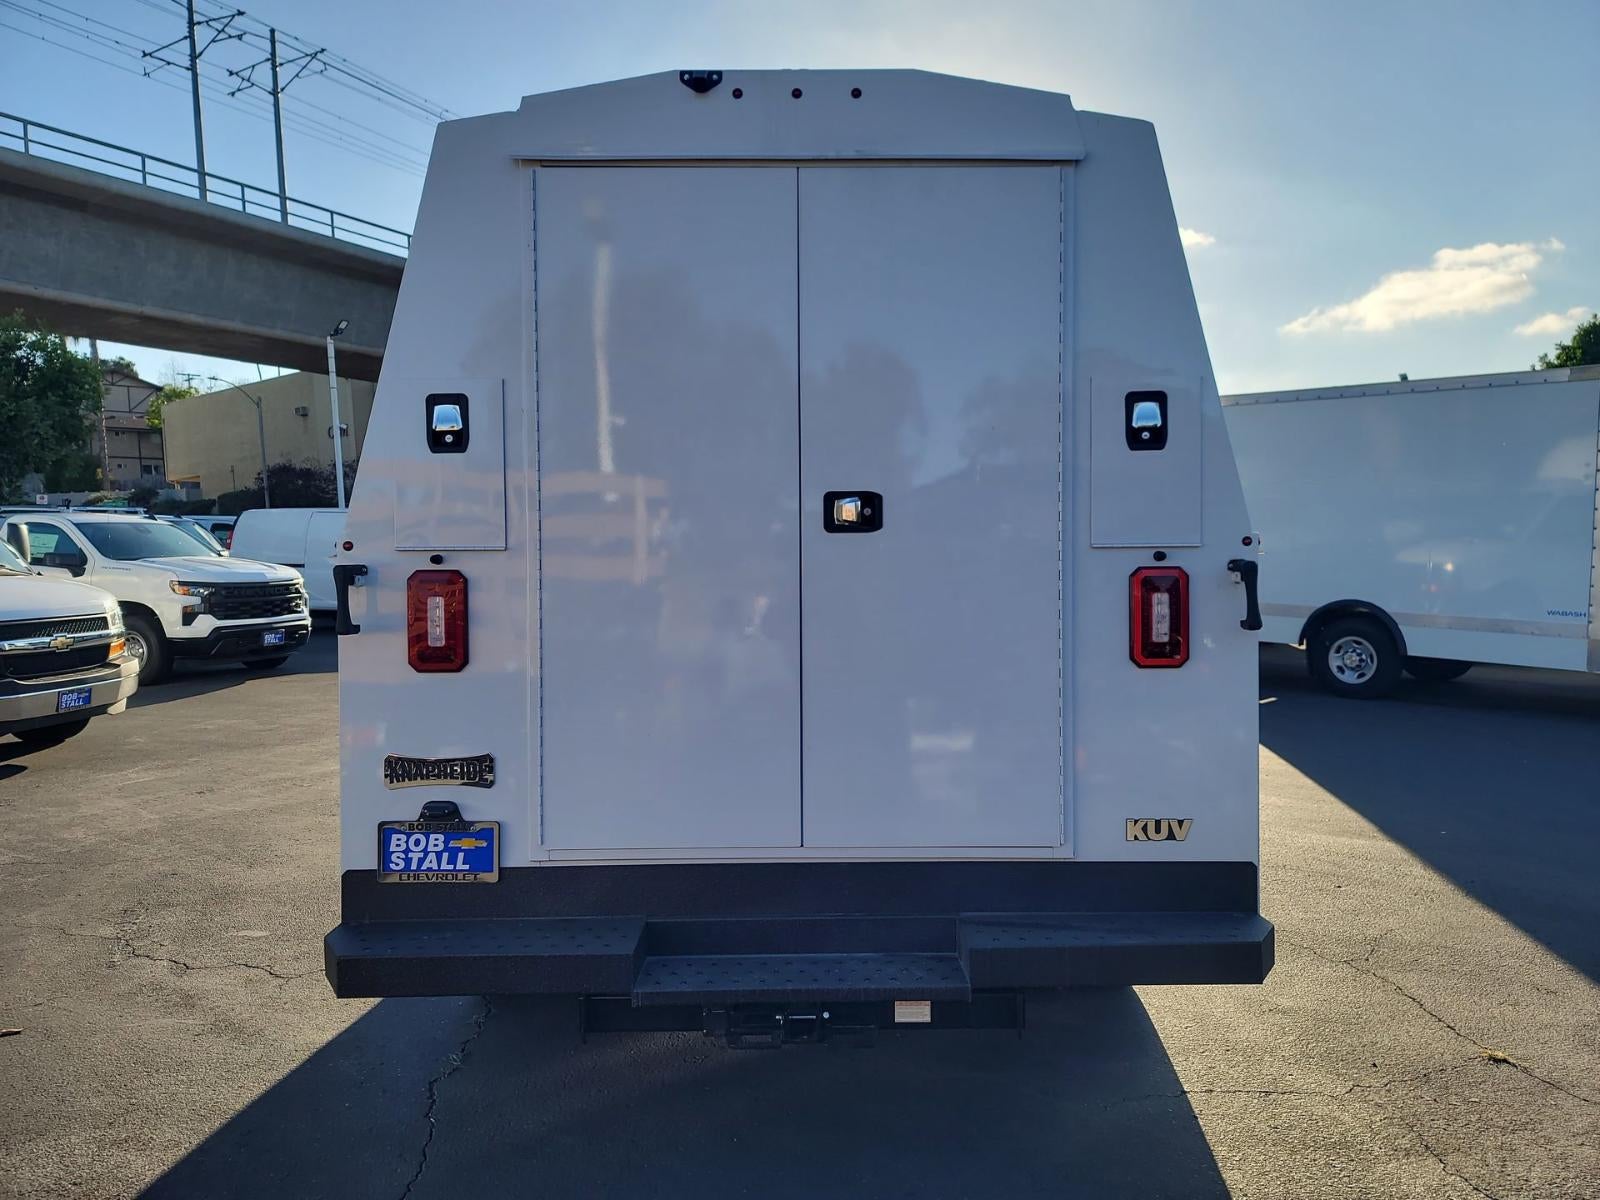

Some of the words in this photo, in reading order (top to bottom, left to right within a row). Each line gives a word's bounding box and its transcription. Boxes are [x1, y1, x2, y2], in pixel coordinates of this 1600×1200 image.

[1546, 609, 1587, 618] WABASH
[62, 693, 78, 702] BOB
[60, 698, 84, 709] STALL
[385, 757, 493, 784] KNAPHEIDE
[407, 822, 432, 832] BOB
[1125, 817, 1193, 841] KUV
[389, 833, 446, 852] BOB
[389, 852, 470, 870] STALL
[398, 872, 480, 882] CHEVROLET
